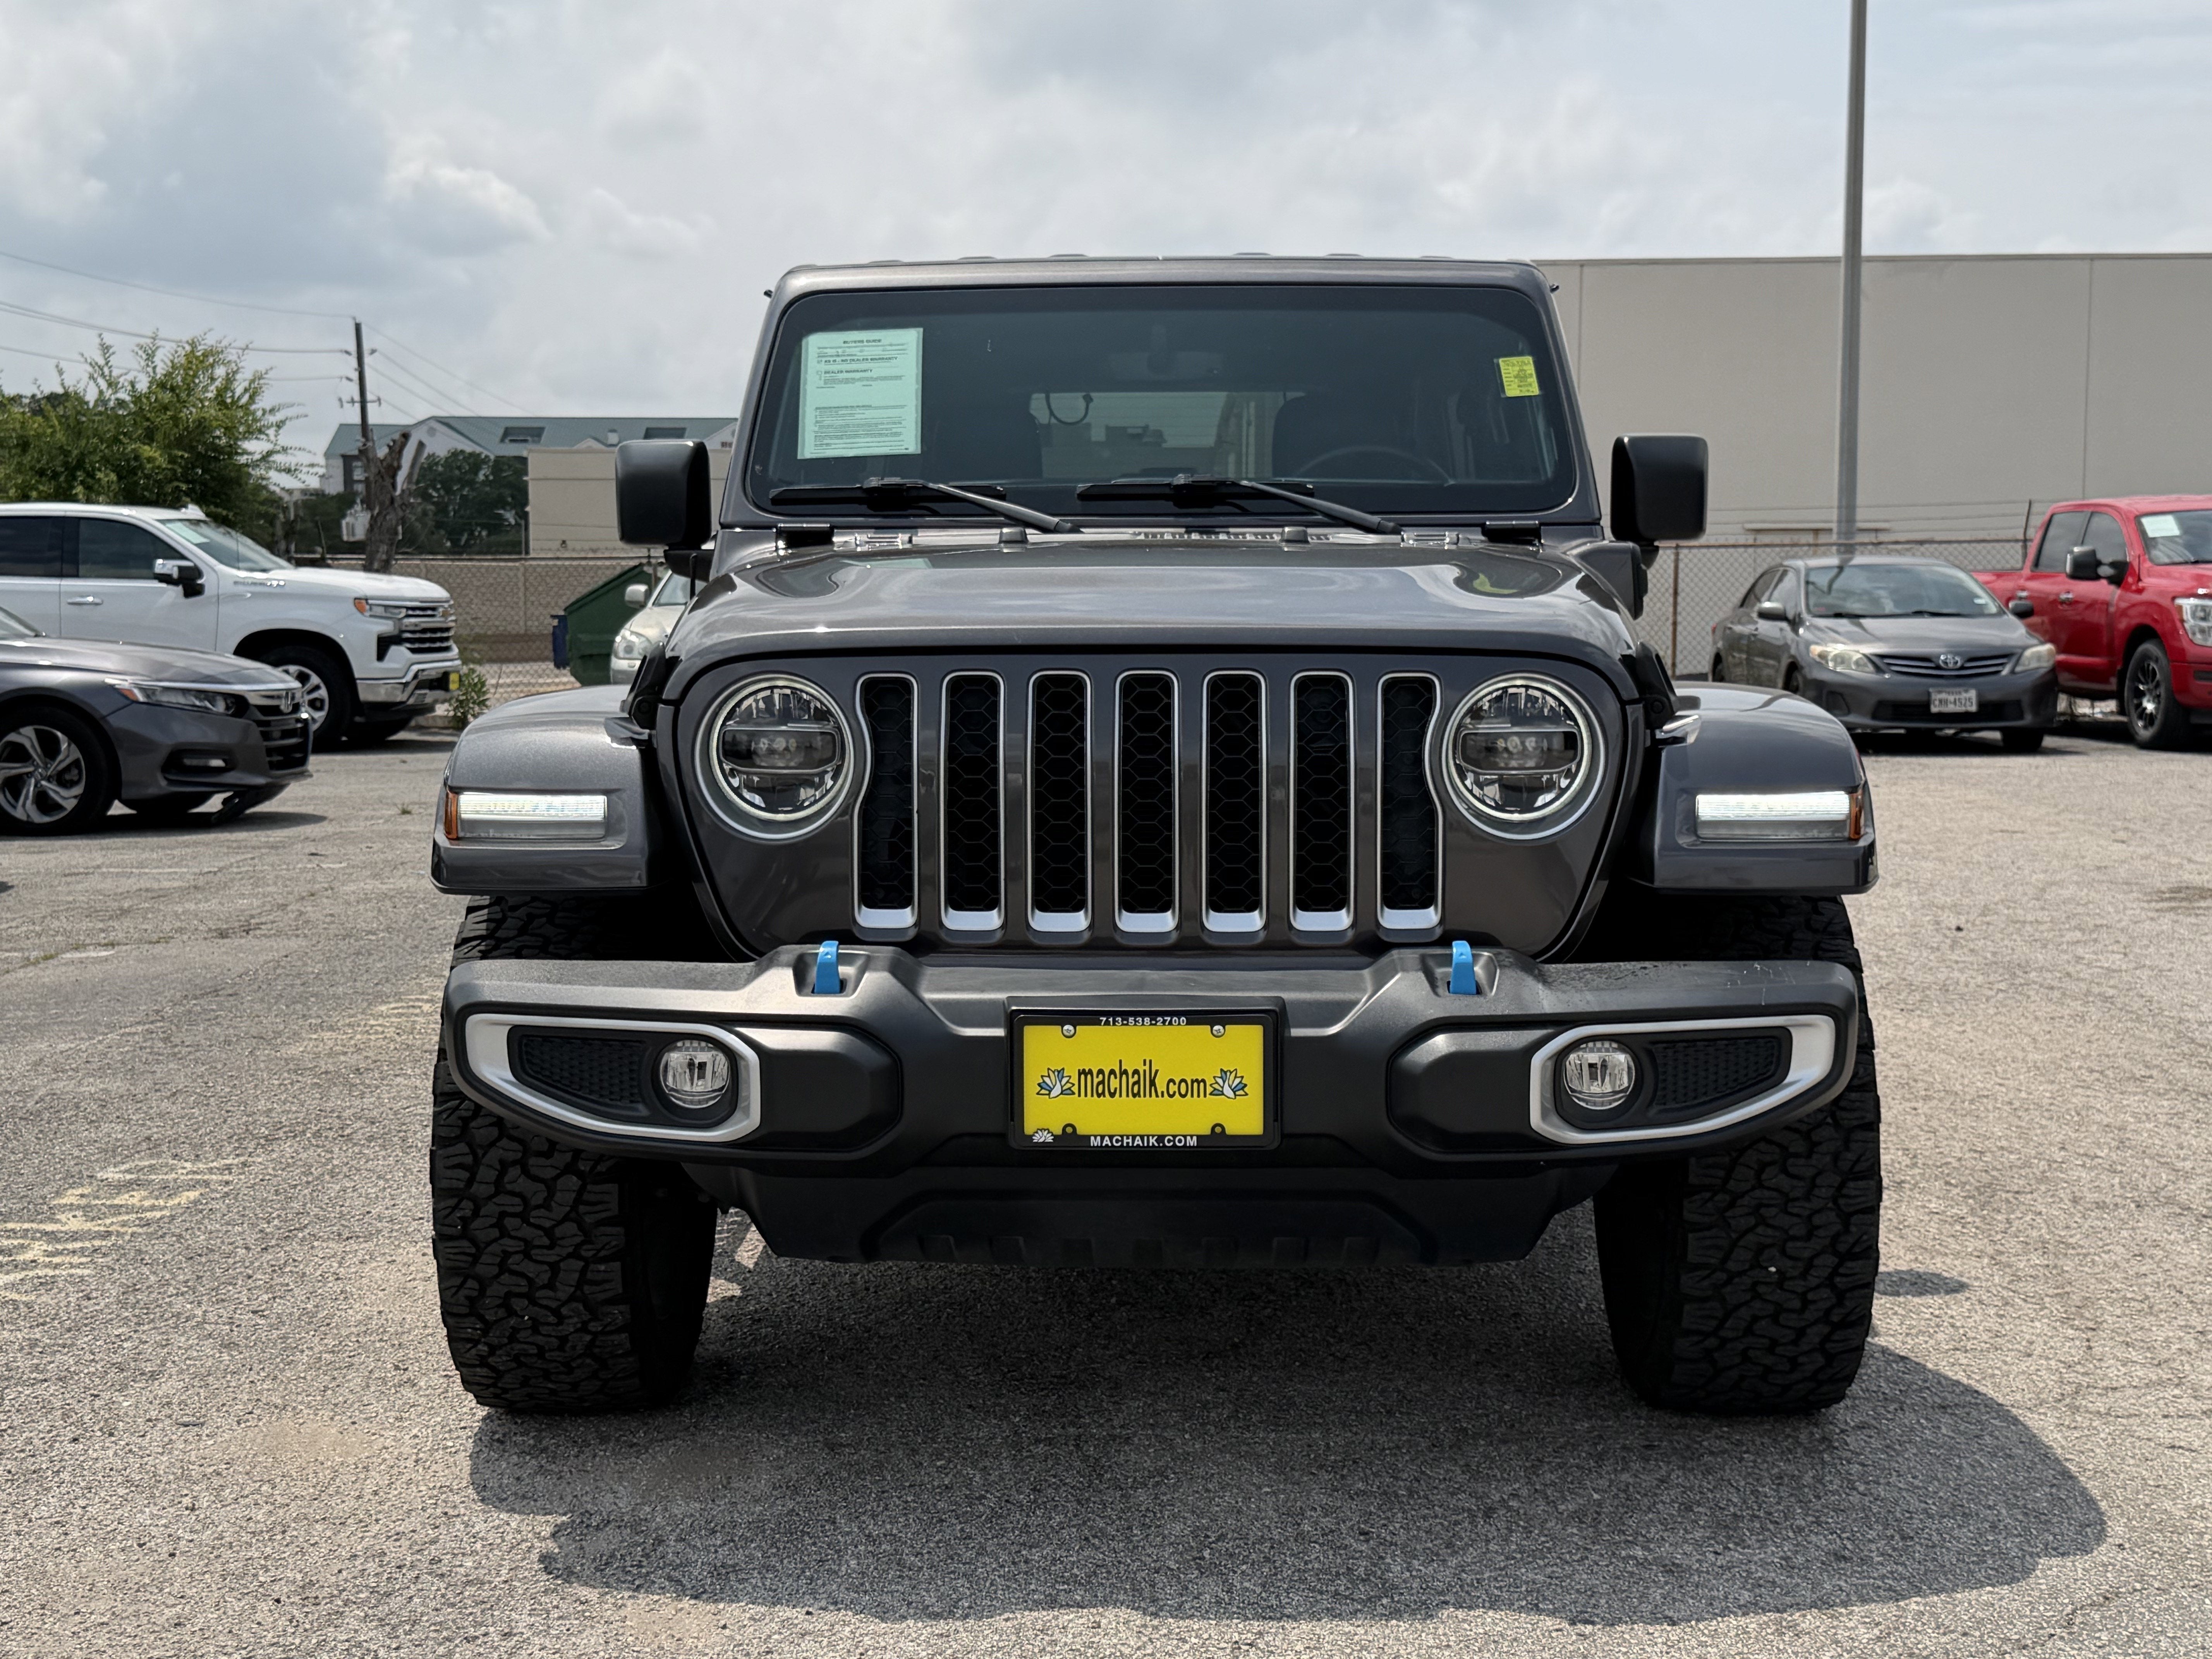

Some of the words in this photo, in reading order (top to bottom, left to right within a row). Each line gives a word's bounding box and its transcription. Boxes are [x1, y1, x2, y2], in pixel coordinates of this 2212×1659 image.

[1099, 1017, 1187, 1026] 713-538-2700
[1077, 1059, 1207, 1099] machaik.com
[1090, 1135, 1197, 1147] MACHAIK.COM
